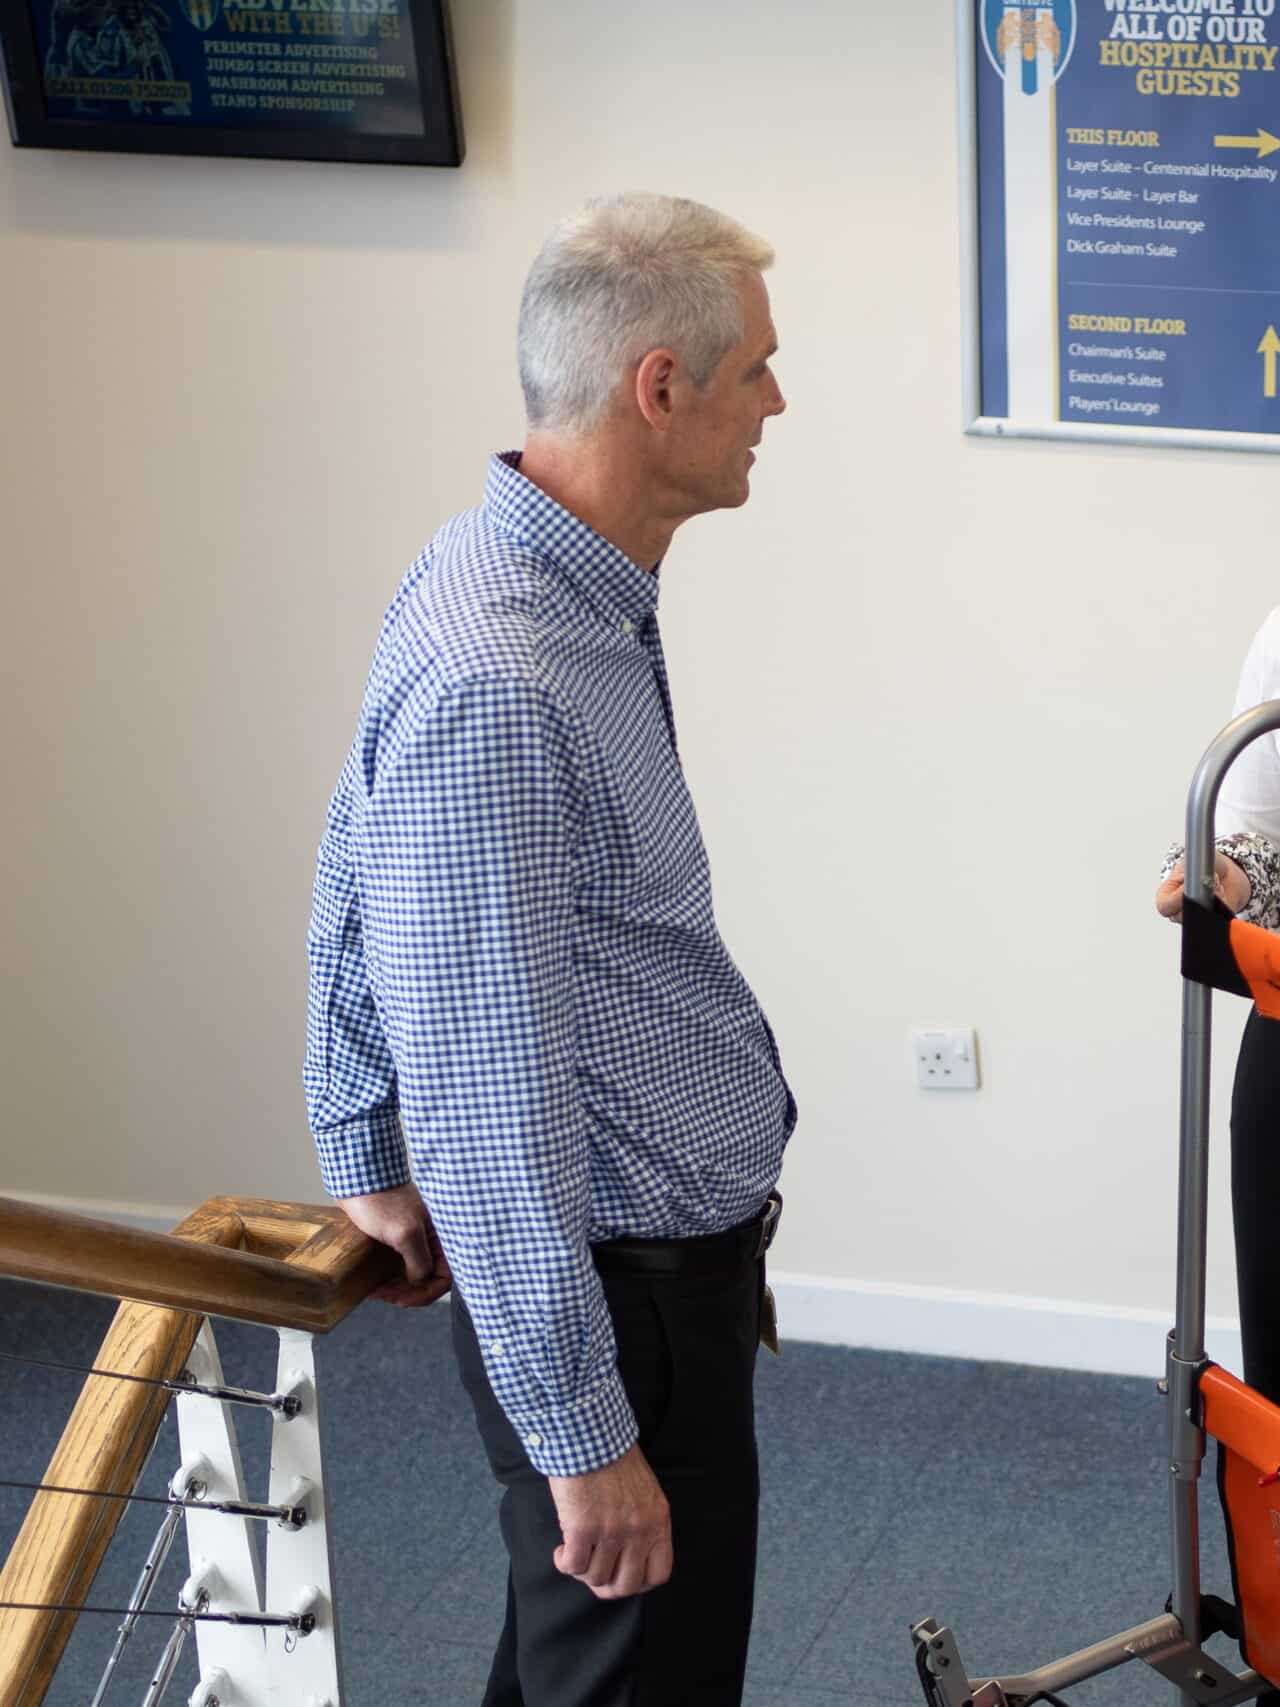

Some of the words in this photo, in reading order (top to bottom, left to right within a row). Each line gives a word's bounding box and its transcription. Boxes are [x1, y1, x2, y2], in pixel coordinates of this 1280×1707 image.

[226, 13, 292, 32] WITH
[299, 15, 345, 34] THE
[1110, 14, 1163, 39] ALL
[1168, 16, 1202, 40] OF
[1207, 17, 1266, 42] OUR
[204, 41, 280, 55] PERIMETER
[285, 45, 377, 59] ADVERTISING
[1100, 41, 1278, 70] HOSPITALITY
[207, 58, 254, 71] JUMBO
[258, 61, 308, 74] SCREEN
[314, 64, 405, 77] ADVERTISING
[209, 76, 288, 90] WASHROOM
[292, 80, 383, 94] ADVERTISING
[1137, 70, 1239, 96] GUESTS
[212, 94, 256, 106] STAND
[261, 97, 353, 110] SPONSORSHIP
[1067, 129, 1102, 144] THIS
[1108, 131, 1159, 146] FLOOR
[1067, 159, 1099, 174] Layer
[1102, 160, 1131, 173] Suite
[1145, 162, 1209, 175] Centennial
[1212, 164, 1277, 181] Hospitality
[1067, 187, 1099, 201] Layer
[1102, 188, 1131, 200] Suite
[1144, 190, 1176, 204] Layer
[1179, 191, 1198, 203] Bar
[1068, 214, 1091, 226] Vice
[1094, 215, 1155, 228] Presidents
[1159, 218, 1204, 232] Lounge
[1068, 240, 1093, 253] Dick
[1097, 242, 1144, 256] Graham
[1147, 244, 1176, 256] Suite
[1069, 315, 1130, 332] SECOND
[1135, 318, 1186, 334] FLOOR
[1135, 348, 1165, 360] Suite
[1070, 371, 1125, 384] Executive
[1128, 374, 1163, 386] Suites
[1115, 400, 1159, 414] Lounge
